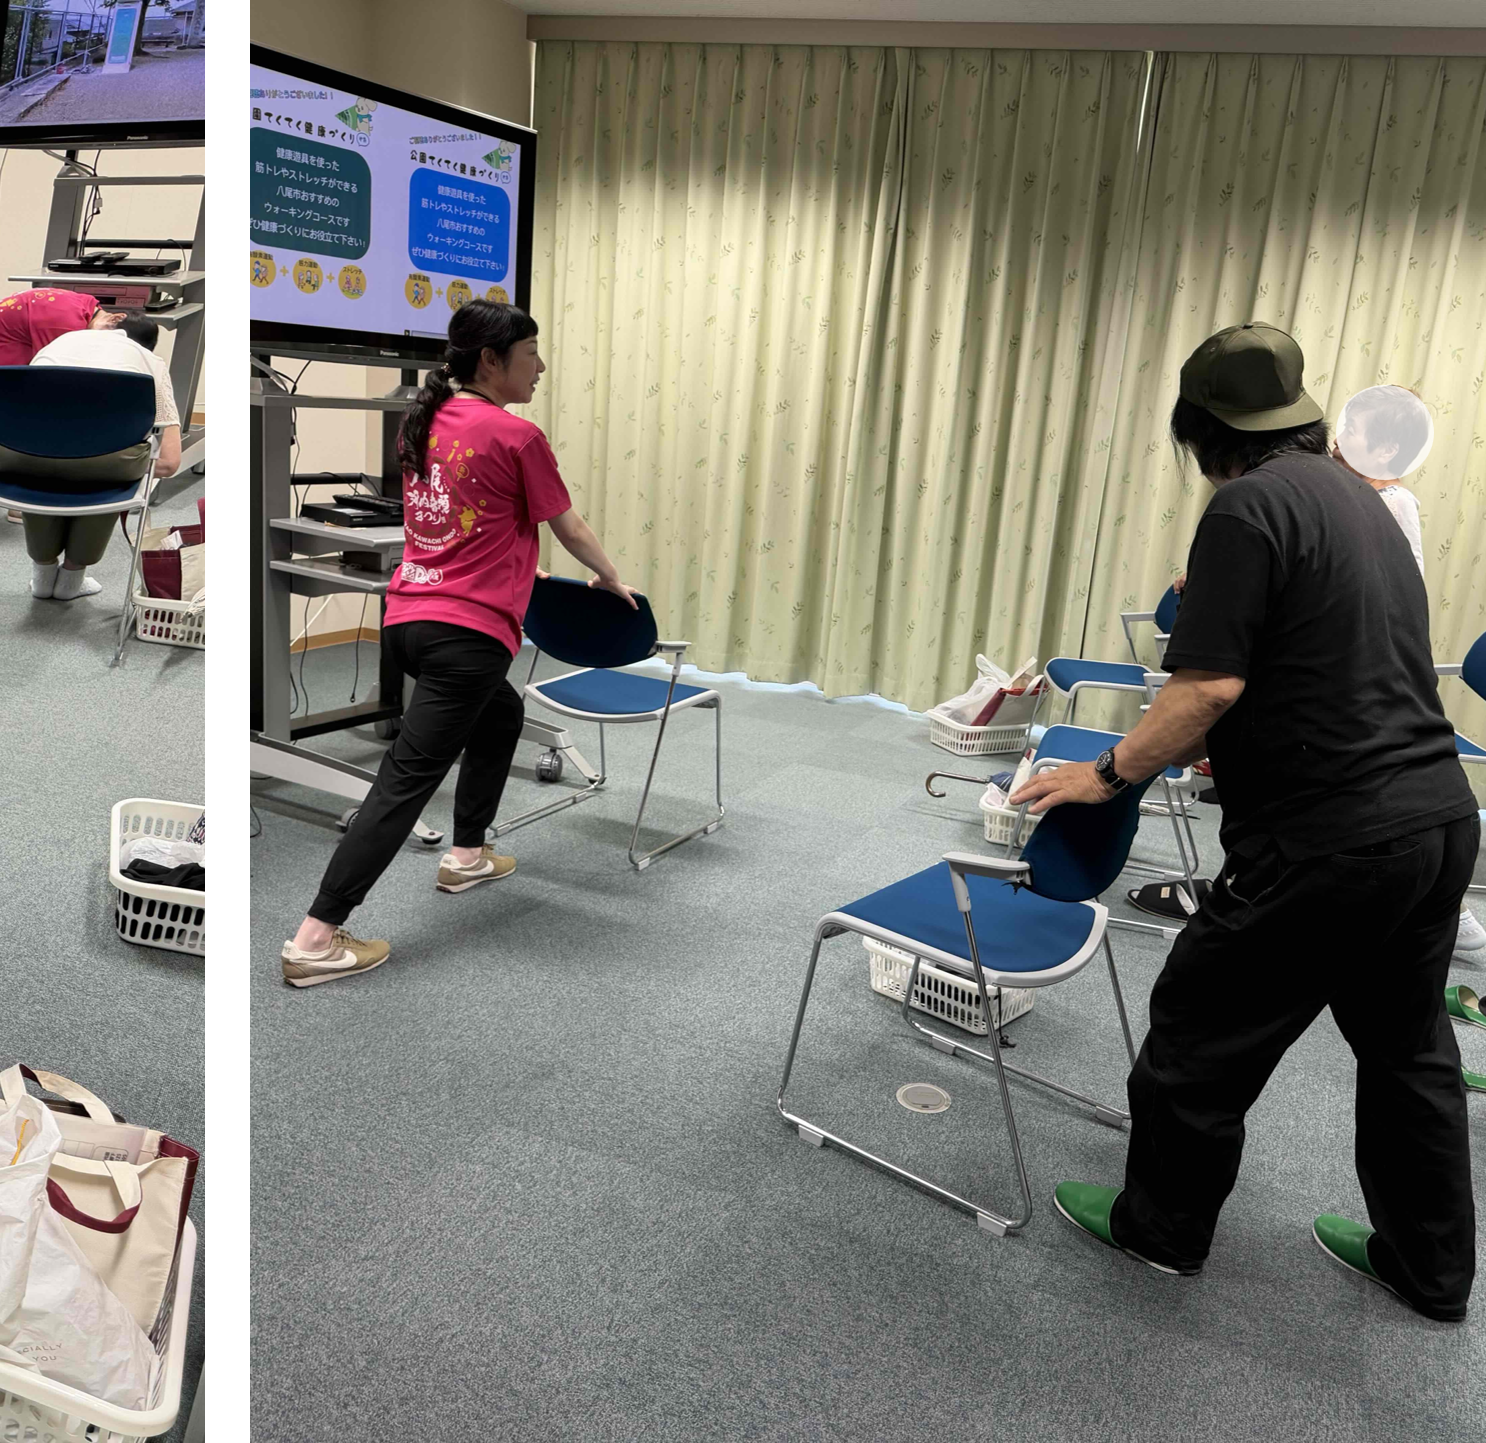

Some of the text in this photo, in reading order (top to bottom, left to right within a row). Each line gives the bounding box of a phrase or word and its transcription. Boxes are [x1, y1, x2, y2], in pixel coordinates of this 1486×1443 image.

[255, 161, 358, 194] 筋トレやストレッチができる
[276, 185, 340, 207] 八尾市おすすめの
[264, 202, 351, 227] ウォーキングコースです
[413, 533, 442, 544] KAWACHI
[414, 541, 444, 551] FESTIVAL
